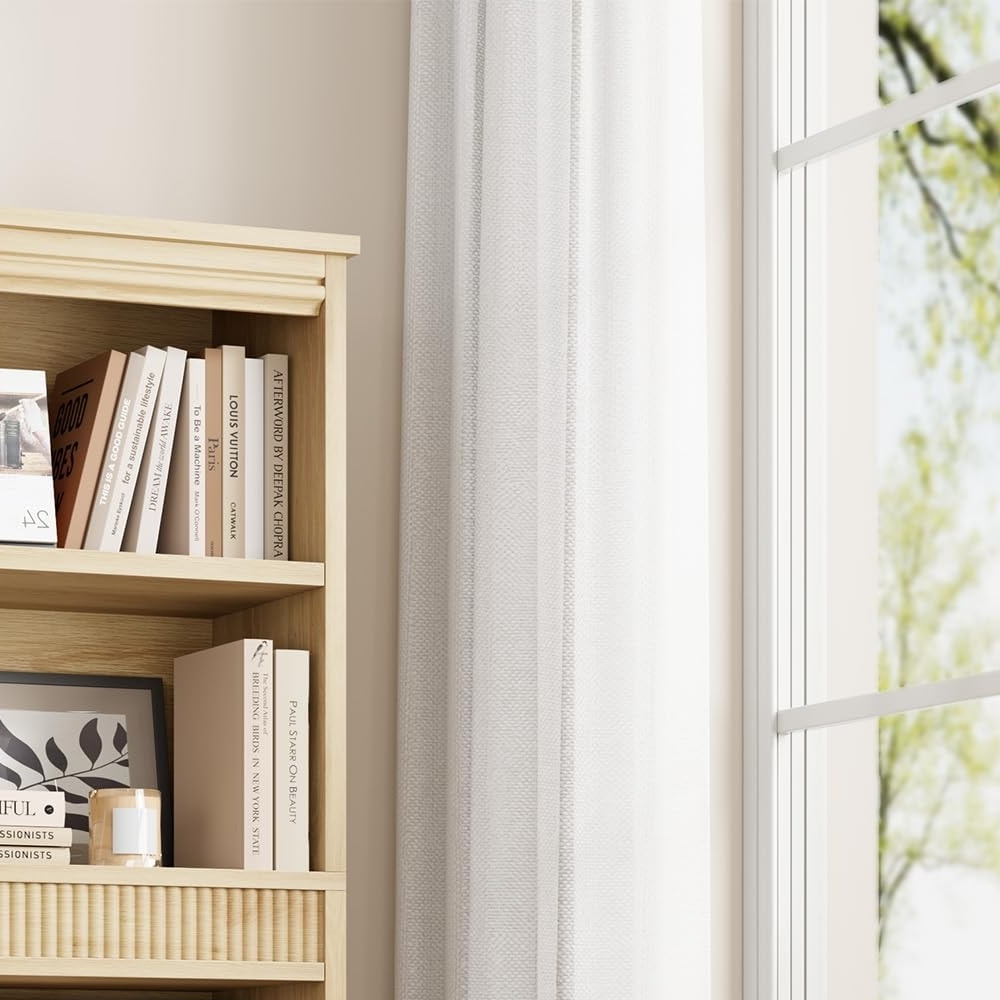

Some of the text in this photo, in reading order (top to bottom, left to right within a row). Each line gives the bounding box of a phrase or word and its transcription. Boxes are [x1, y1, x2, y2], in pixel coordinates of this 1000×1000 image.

[117, 399, 131, 430] GUIDE
[122, 471, 131, 485] for
[130, 410, 147, 461] sustainable
[140, 372, 155, 408] lifestyle
[194, 406, 202, 416] To
[194, 419, 202, 433] Be
[111, 432, 123, 462] GOOD
[208, 438, 219, 472] Paris
[229, 395, 238, 478] LOUIS VUITTON
[109, 463, 116, 471] A
[149, 474, 162, 512] DREAM
[160, 403, 173, 439] AWAKE
[194, 445, 202, 486] Machine
[273, 369, 283, 558] AFTERWORD BY DEEPAK CHOPRA
[100, 484, 111, 505] THIS
[252, 672, 260, 856] BREEDING BIRDS IN NEW YORK STATE
[289, 700, 298, 825] PAUL STARR ON BEAUTY
